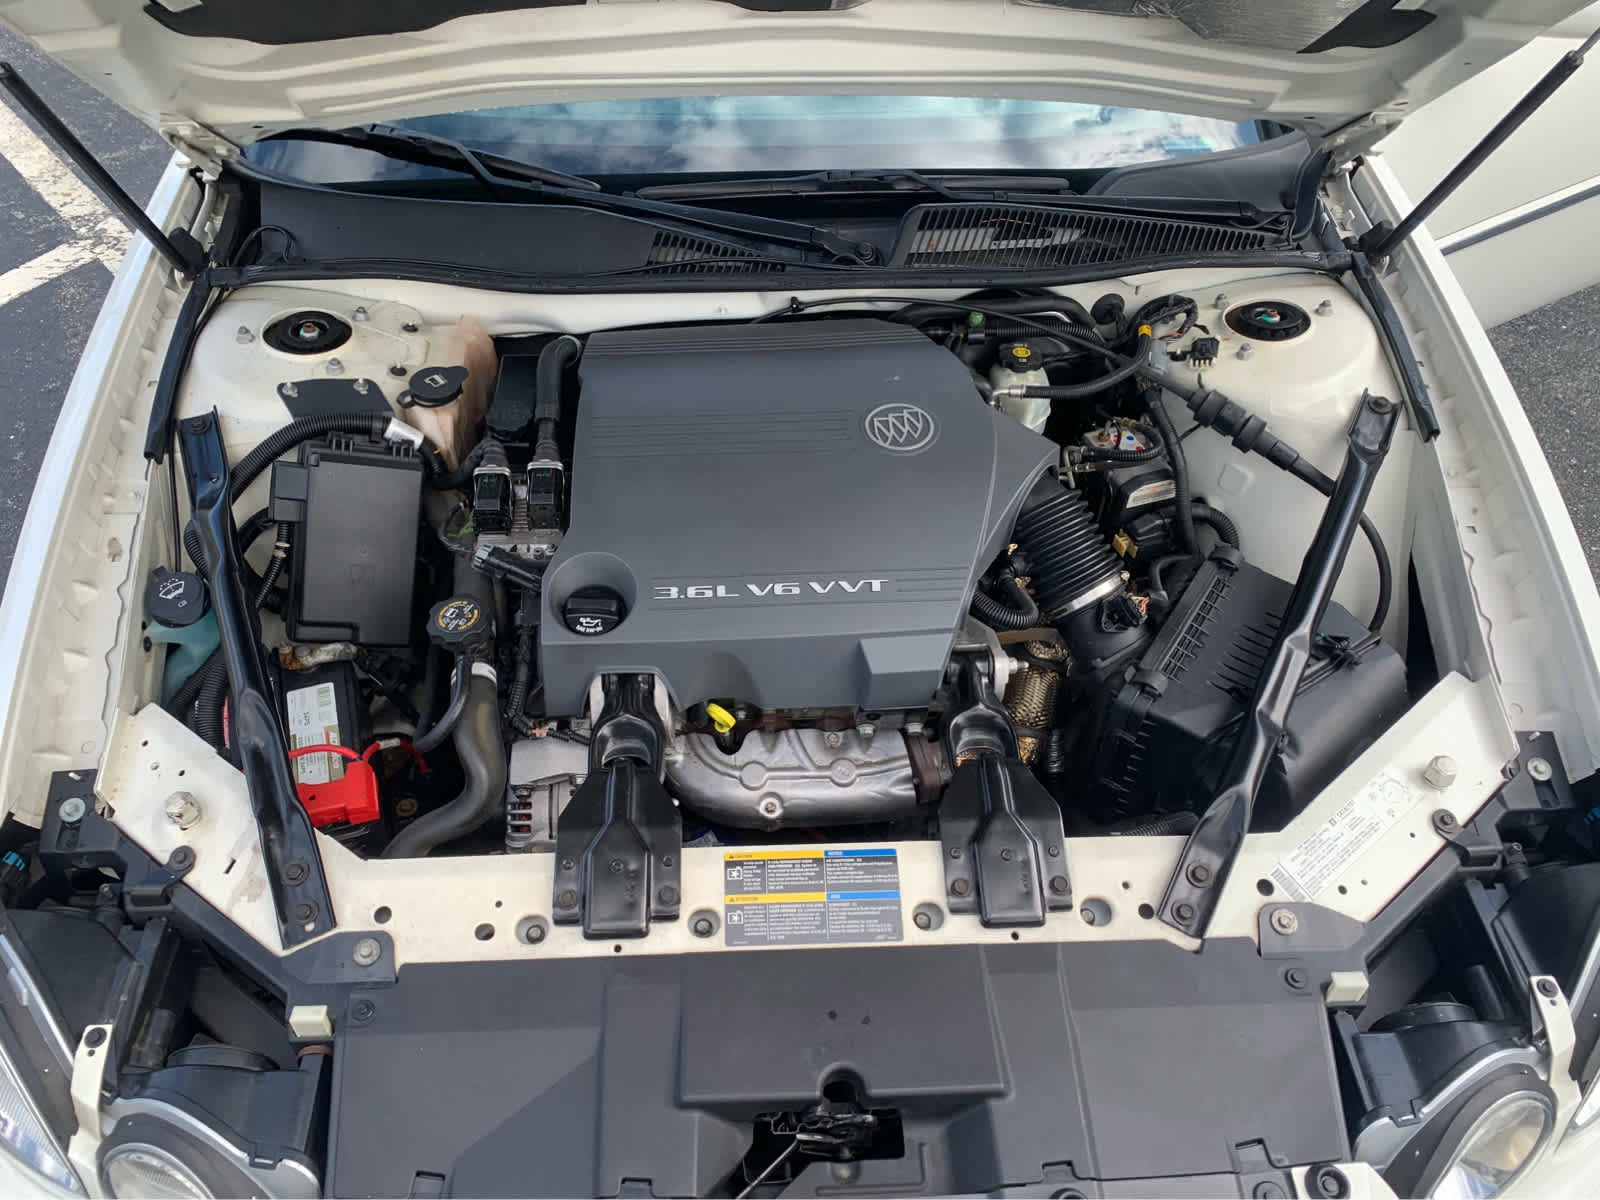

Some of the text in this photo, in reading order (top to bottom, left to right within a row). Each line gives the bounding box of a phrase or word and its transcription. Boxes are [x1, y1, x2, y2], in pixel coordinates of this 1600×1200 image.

[653, 579, 889, 600] 3.6L V6 VVT
